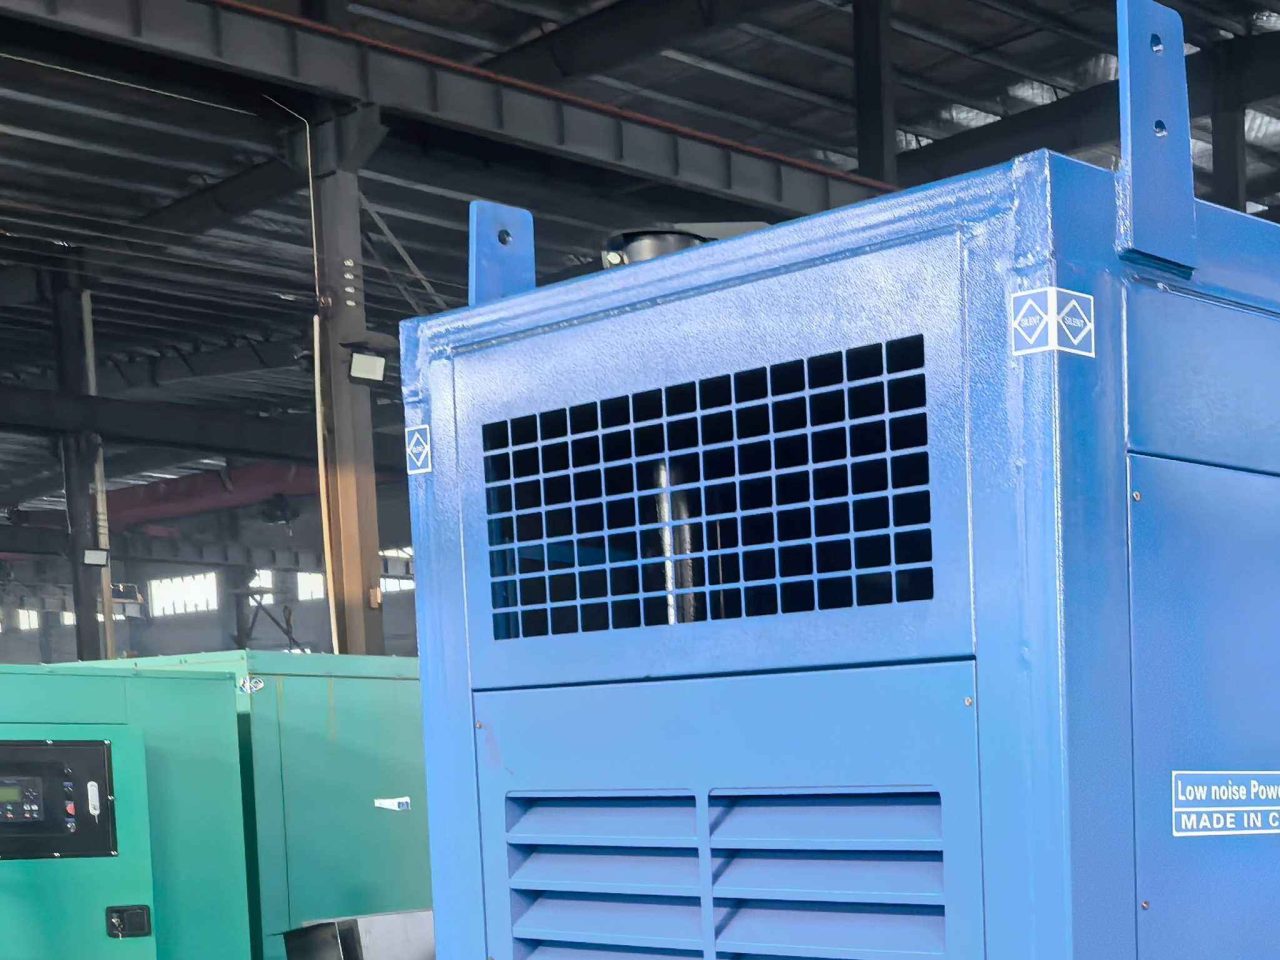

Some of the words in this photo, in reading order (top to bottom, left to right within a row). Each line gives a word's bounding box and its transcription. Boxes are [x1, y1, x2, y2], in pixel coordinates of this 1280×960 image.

[1177, 780, 1207, 801] Low
[1211, 780, 1247, 801] noise
[1181, 812, 1236, 830] MADE
[1243, 812, 1262, 828] IN
